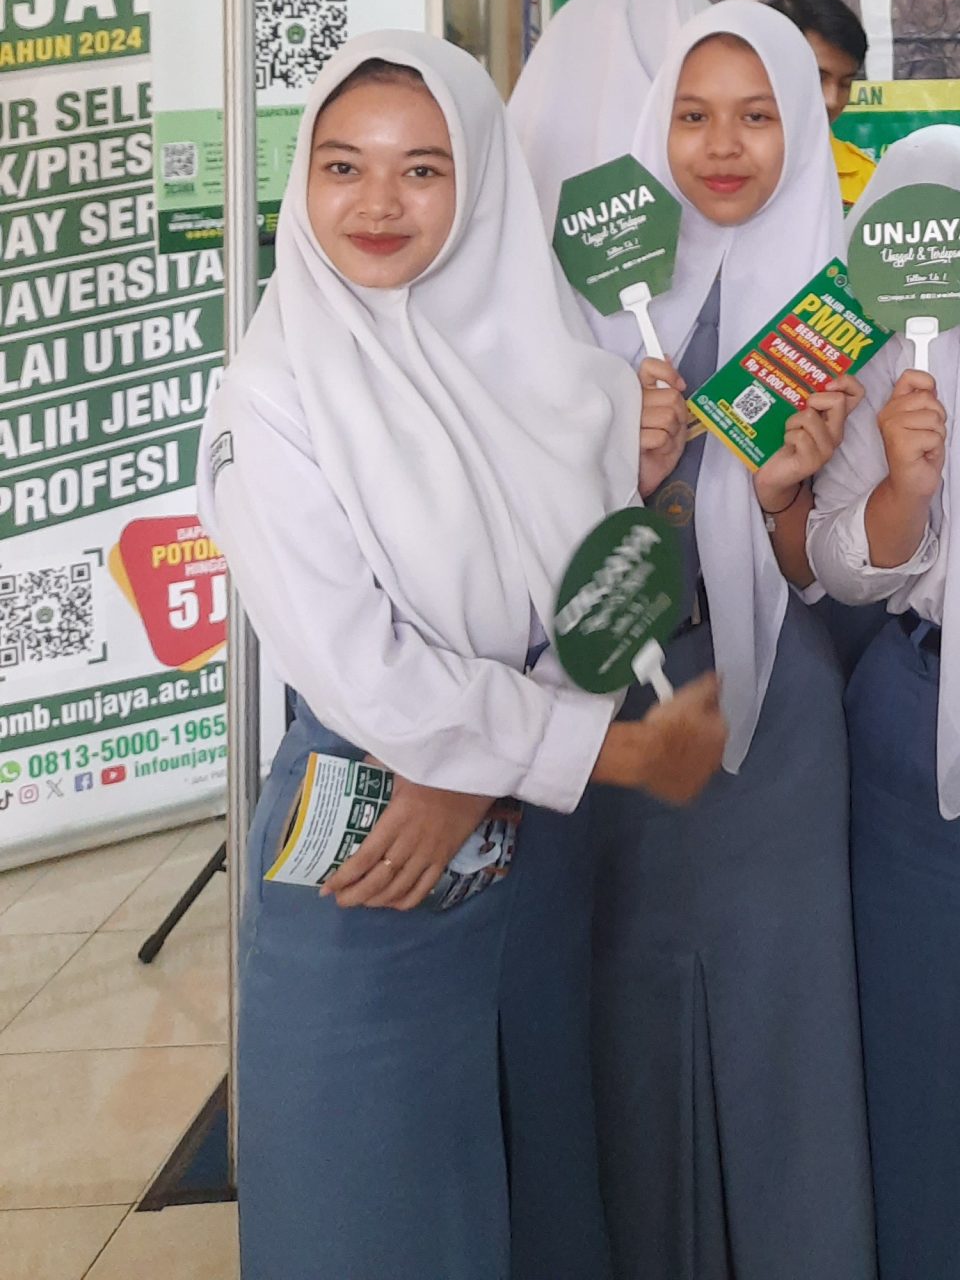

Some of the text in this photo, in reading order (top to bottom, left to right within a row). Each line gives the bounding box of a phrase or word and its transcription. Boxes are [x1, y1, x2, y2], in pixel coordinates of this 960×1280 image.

[79, 25, 143, 55] 2024
[0, 208, 66, 261] AY
[562, 185, 656, 236] UNJAYA
[880, 247, 915, 268] Unggul
[916, 246, 927, 261] &
[0, 249, 225, 328] AVERSITA
[792, 293, 874, 360] PMDK
[821, 293, 873, 335] JALUR SELEKSI
[83, 309, 203, 374] UTBK
[771, 338, 827, 382] PAKAI RAPOR
[795, 323, 840, 361] BEBAS TES
[745, 358, 760, 372] Rp
[758, 368, 805, 407] 5.000.000,-
[168, 580, 199, 630] 5
[28, 713, 227, 779] 0813-5000-1965
